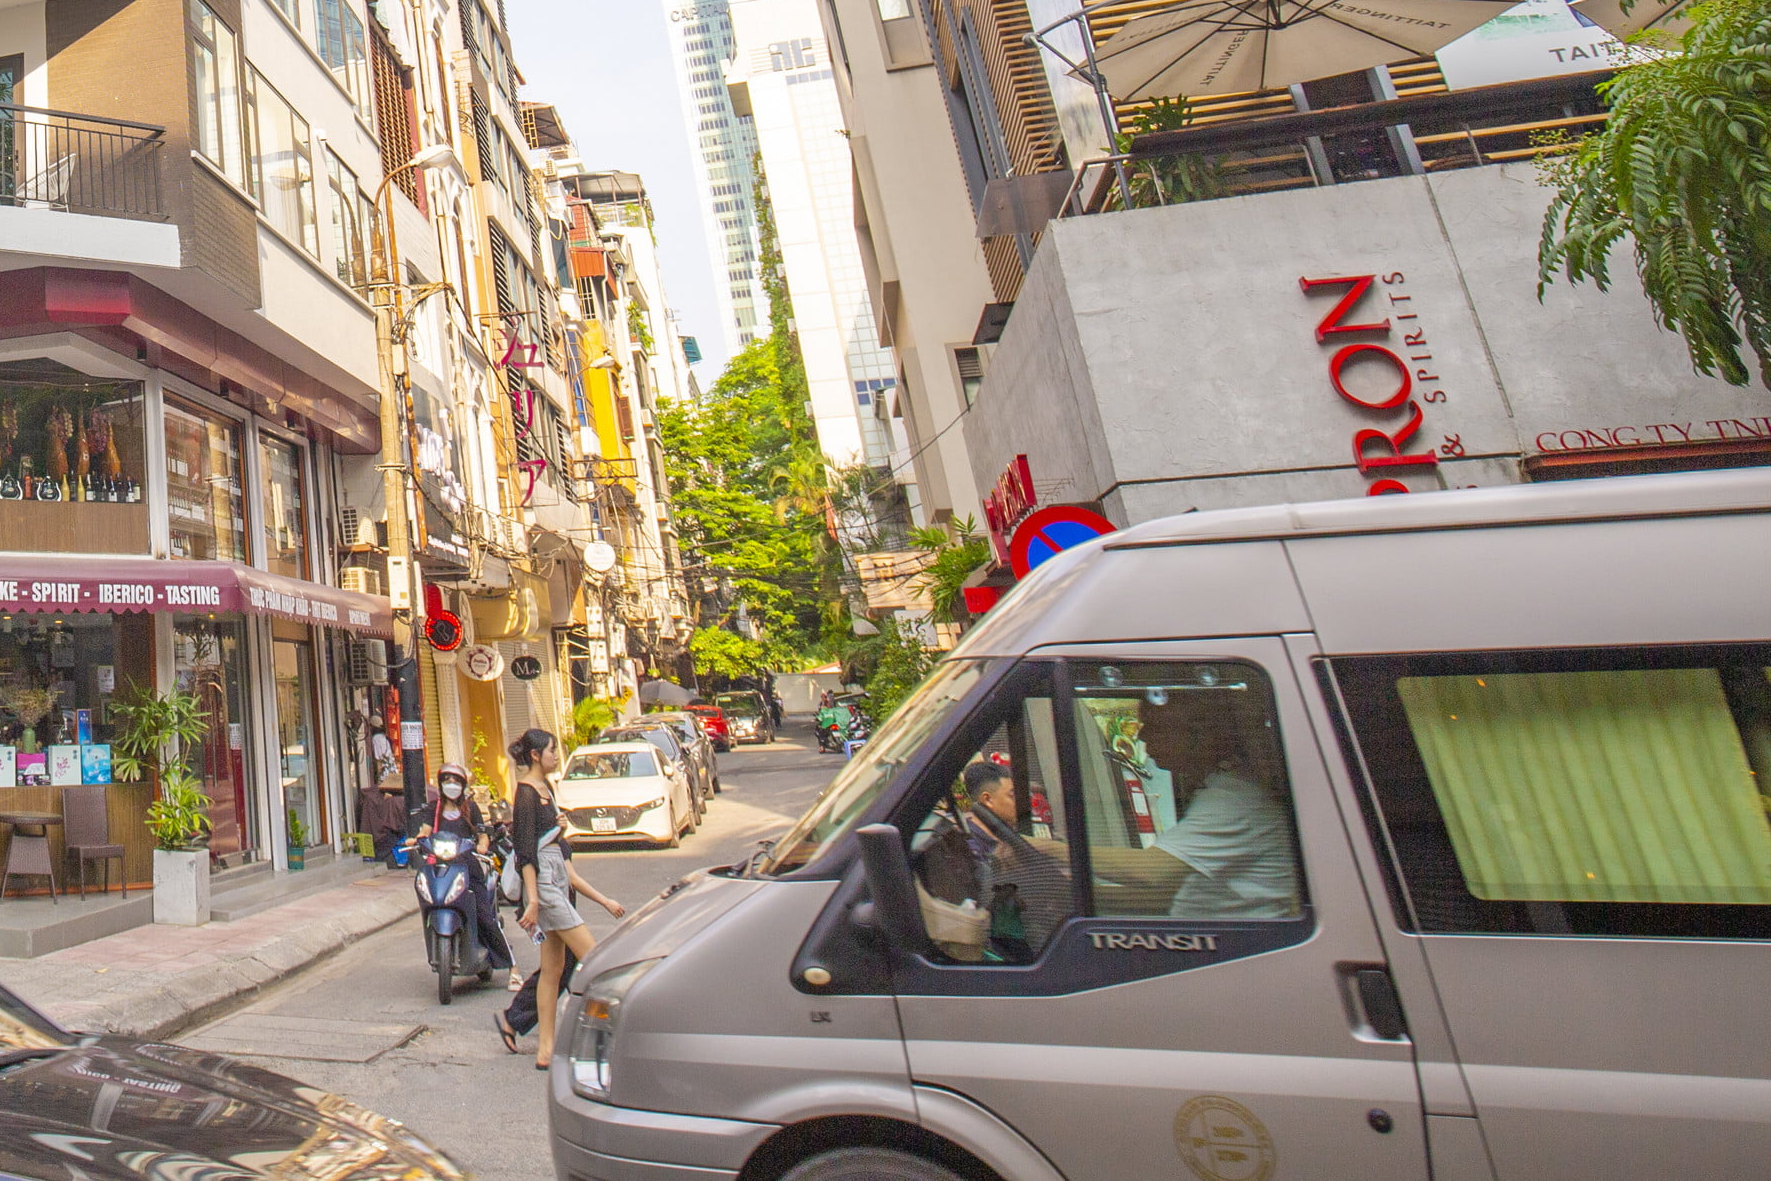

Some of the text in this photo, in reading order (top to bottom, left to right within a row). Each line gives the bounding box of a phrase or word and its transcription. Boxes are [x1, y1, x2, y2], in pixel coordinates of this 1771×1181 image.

[1382, 271, 1447, 403] SPIRITS
[1646, 422, 1692, 446] TY
[32, 582, 80, 603] SPIRIT
[99, 584, 153, 604] IBERICO
[165, 585, 220, 605] TASTING
[1087, 932, 1218, 951] TRANSIT
